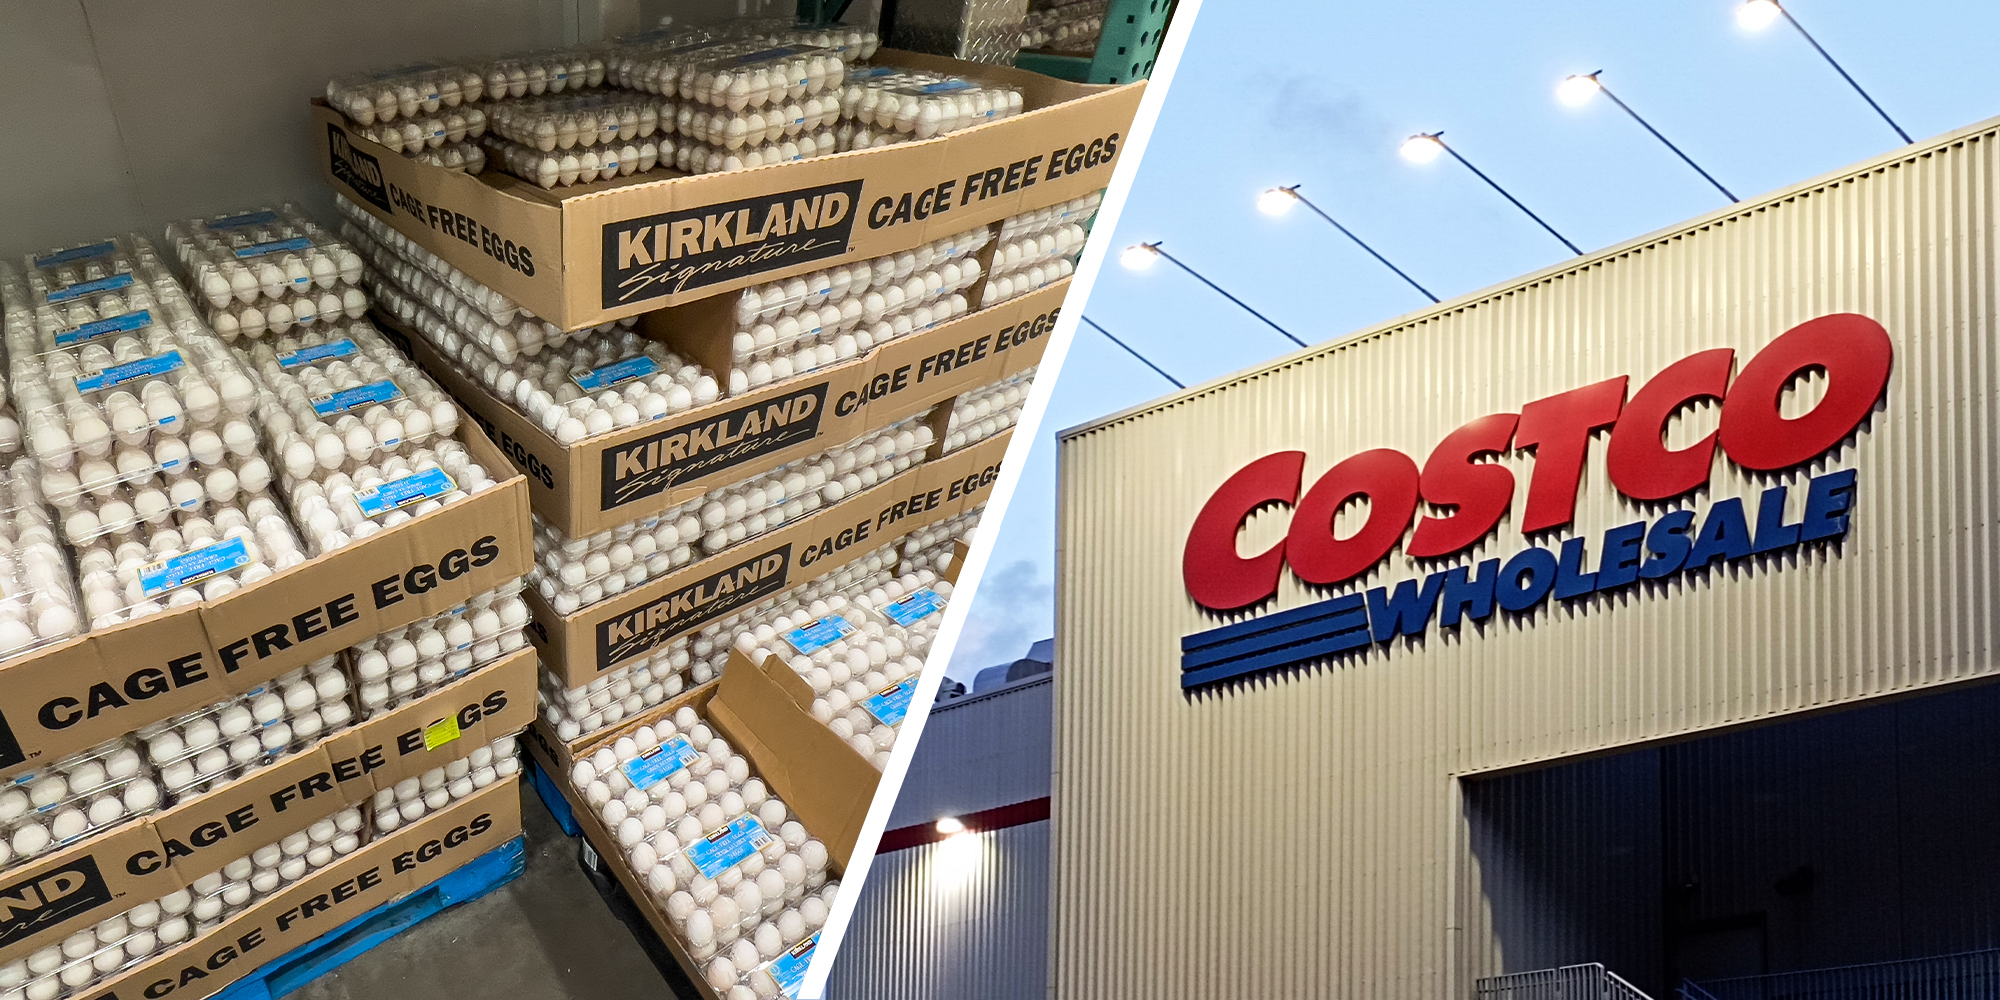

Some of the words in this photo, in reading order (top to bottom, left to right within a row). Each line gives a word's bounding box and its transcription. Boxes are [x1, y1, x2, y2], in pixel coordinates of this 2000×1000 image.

[867, 179, 957, 230] CAGE
[960, 154, 1044, 207] FREE
[1045, 132, 1120, 182] EGGS
[388, 182, 428, 226] CAGE
[426, 204, 479, 249] FREE
[480, 224, 536, 278] EGGS
[618, 191, 850, 271] KIRKLAND
[618, 237, 841, 301] Signature
[834, 364, 911, 418] CAGE
[916, 333, 993, 384] FREE
[501, 430, 555, 491] EGGS
[614, 428, 810, 504] Signature
[615, 393, 818, 482] KIRKLAND
[1182, 312, 1893, 611] COSTCO
[799, 518, 872, 568] CAGE
[876, 488, 943, 532] FREE
[1365, 468, 1857, 645] WHOLESALE
[37, 651, 209, 731] CAGE
[218, 592, 360, 675] FREE
[371, 534, 500, 610] EGGS
[608, 553, 783, 647] KIRKLAND
[609, 580, 779, 664] Signature
[125, 803, 260, 877] CAGE
[269, 744, 386, 814] FREE
[396, 689, 508, 757] EGS
[143, 927, 266, 1000] CAGE
[275, 866, 383, 933] FREE
[391, 812, 493, 875] EGGS
